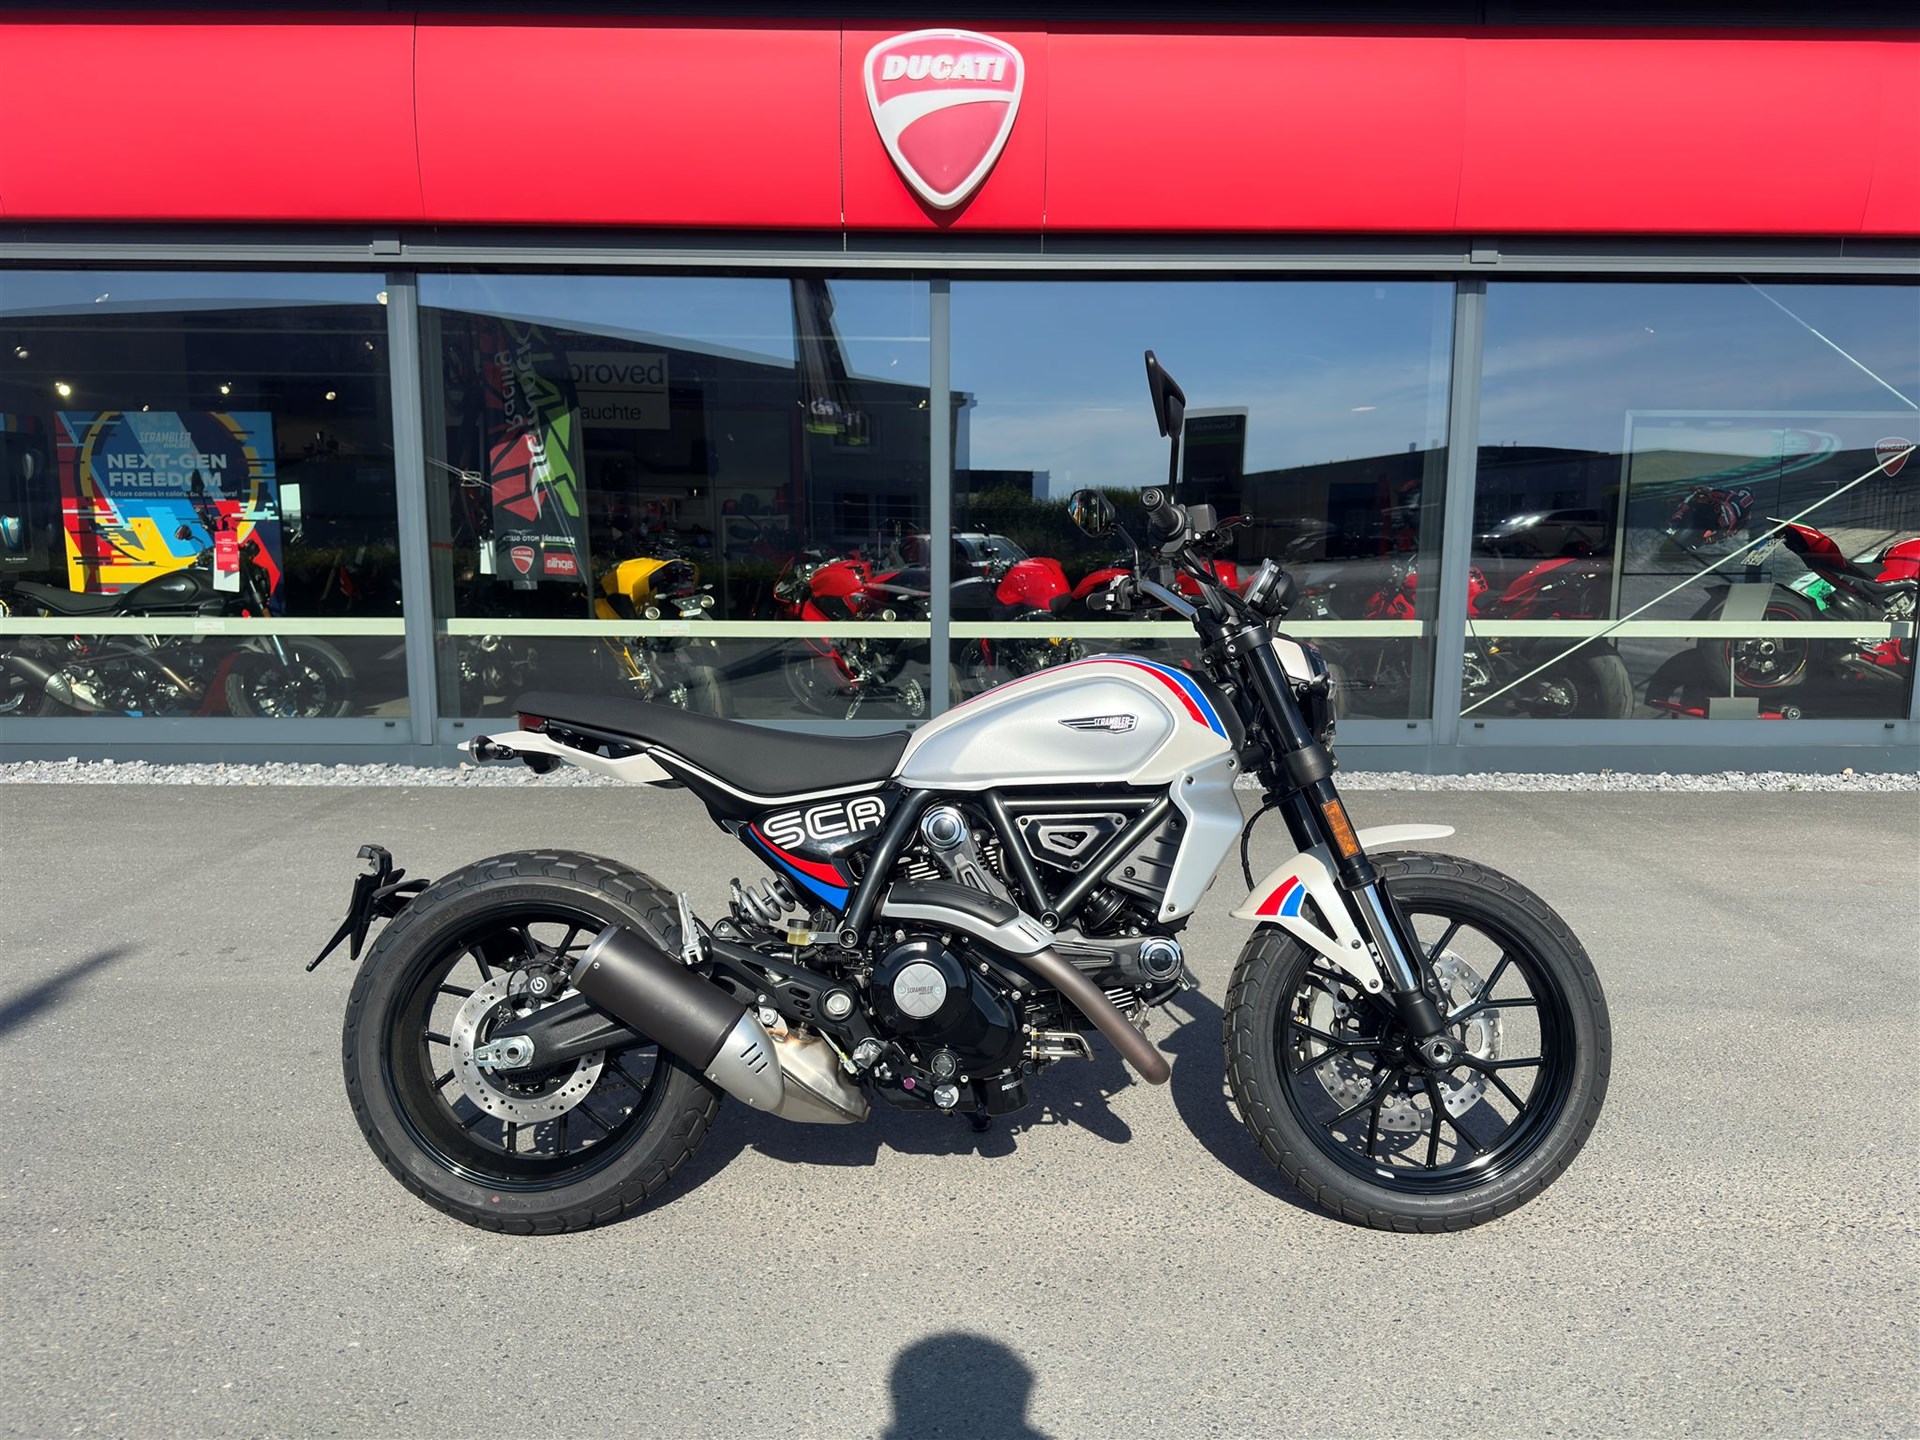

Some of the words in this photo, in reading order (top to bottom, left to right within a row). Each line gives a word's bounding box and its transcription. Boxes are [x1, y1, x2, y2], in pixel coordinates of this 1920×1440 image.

[882, 55, 1006, 82] DUCATI
[139, 432, 192, 444] SCRAMBLER
[107, 453, 227, 469] NEXT-GEN
[110, 490, 133, 498] Future
[134, 490, 157, 498] comes
[158, 490, 165, 498] in
[1093, 716, 1131, 726] SCRAMBLER
[763, 796, 886, 850] SCR
